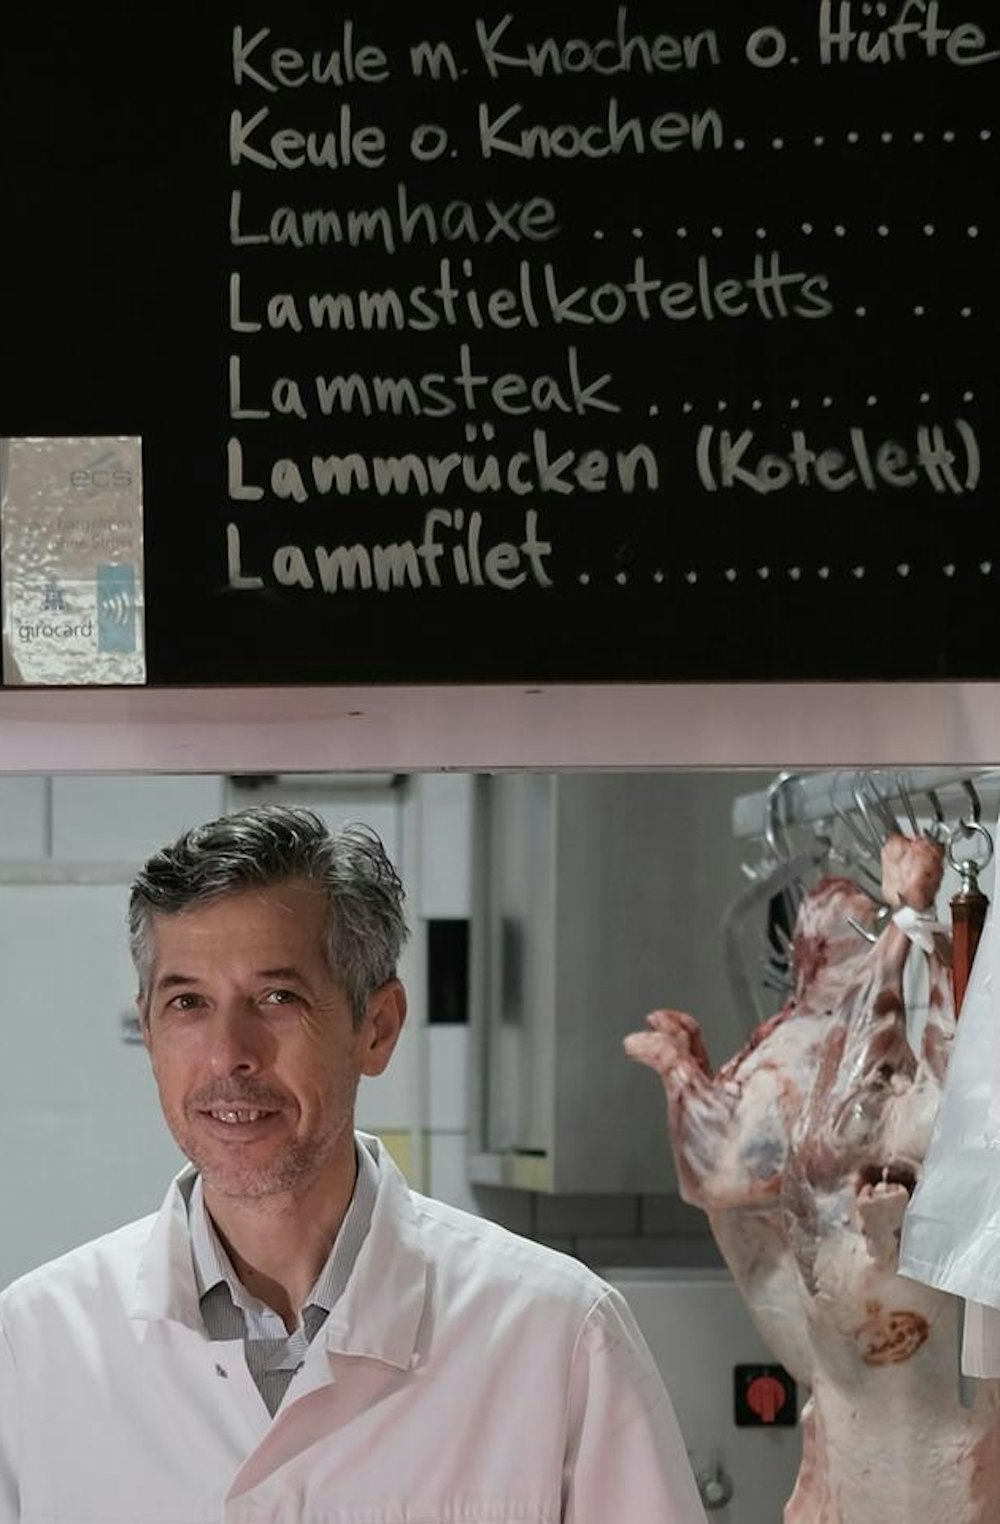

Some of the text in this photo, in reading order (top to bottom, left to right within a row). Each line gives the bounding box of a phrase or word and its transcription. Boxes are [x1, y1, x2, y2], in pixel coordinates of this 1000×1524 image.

[233, 21, 389, 92] Keule
[411, 38, 468, 79] m.
[476, 8, 719, 77] Knochen
[746, 27, 798, 67] o.
[230, 98, 722, 169] Keule o. Knochen
[230, 184, 558, 254] Lammhaxe
[230, 255, 833, 332] Lammstielkoteletts
[230, 344, 620, 419] Lammsteak
[228, 420, 980, 502] Lammrücken (Kotelett)
[227, 508, 552, 592] Lammfilet
[18, 621, 92, 643] girocard
